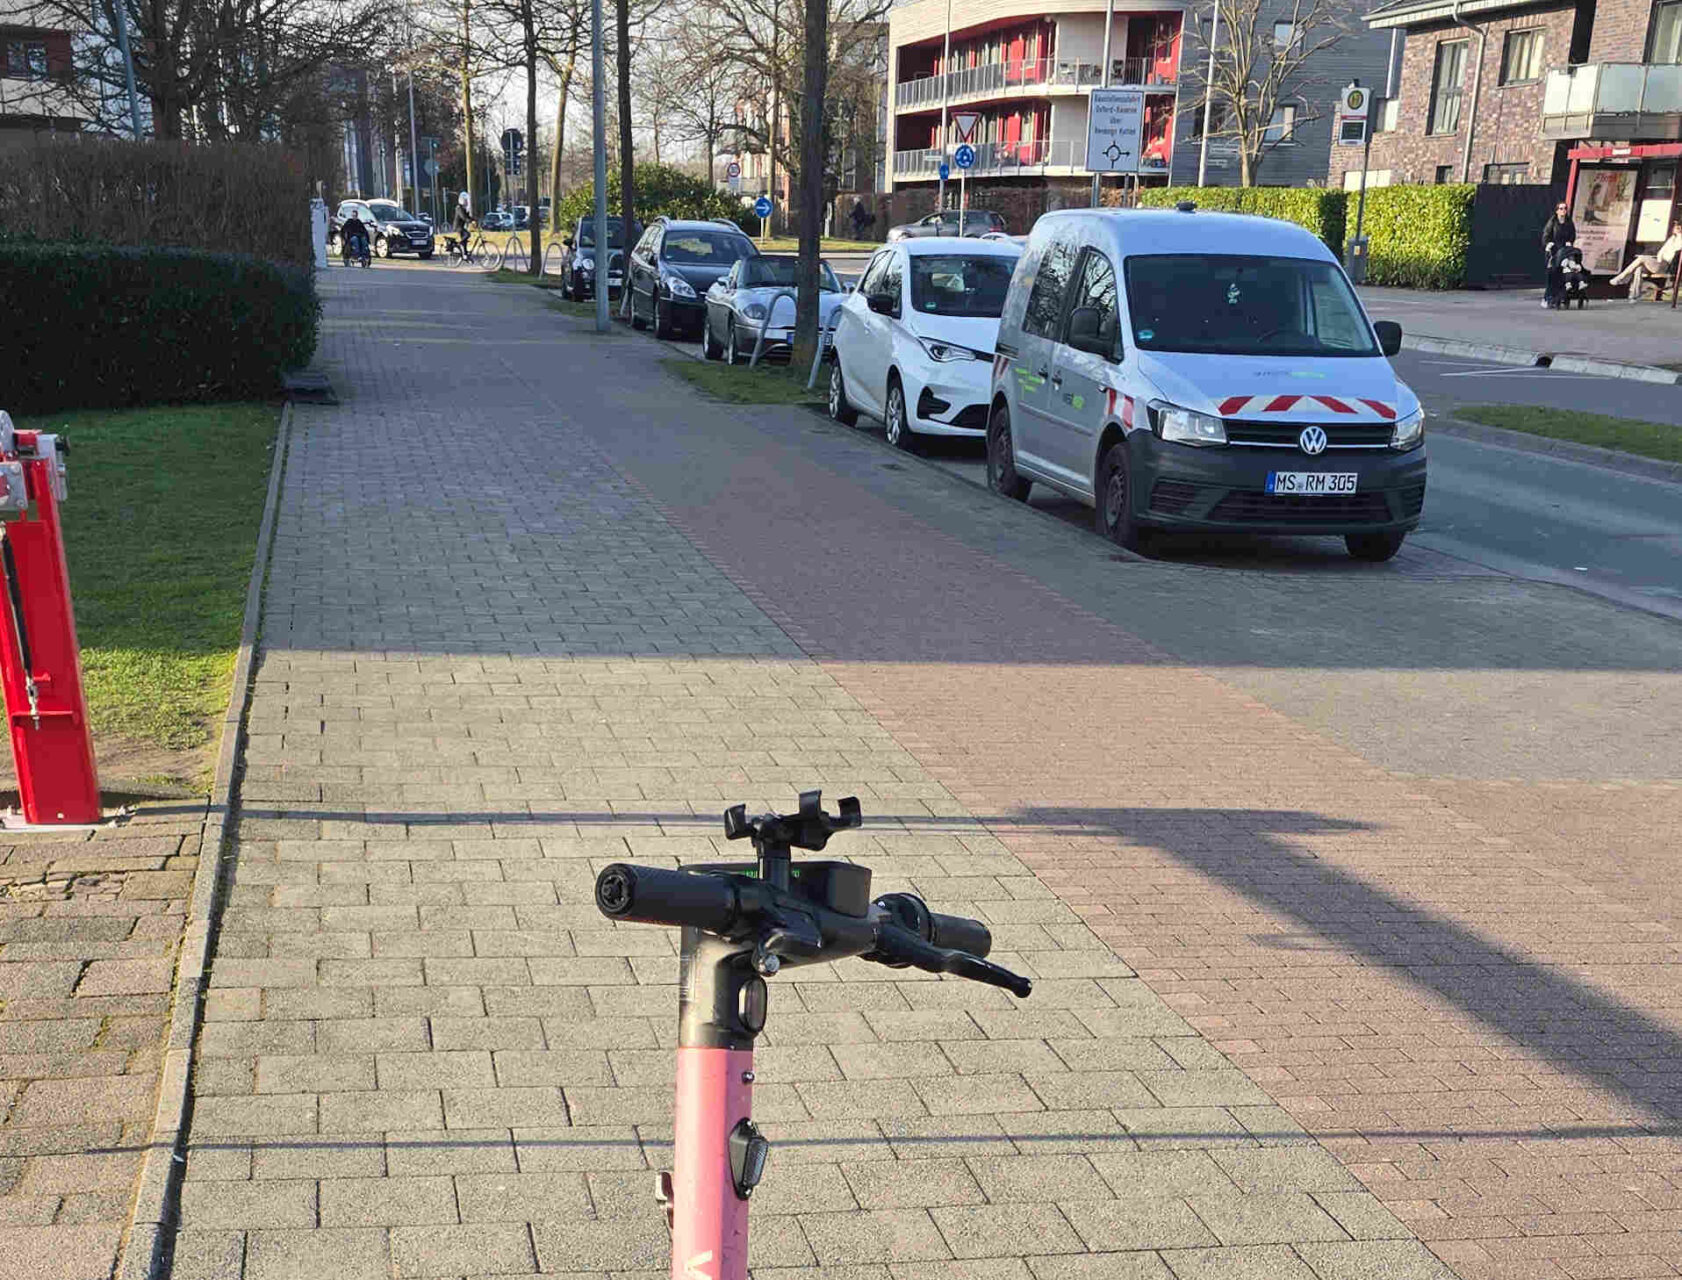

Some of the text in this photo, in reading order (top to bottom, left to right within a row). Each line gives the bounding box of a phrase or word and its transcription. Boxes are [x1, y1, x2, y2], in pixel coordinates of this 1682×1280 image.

[1276, 474, 1356, 491] MS RM 305
